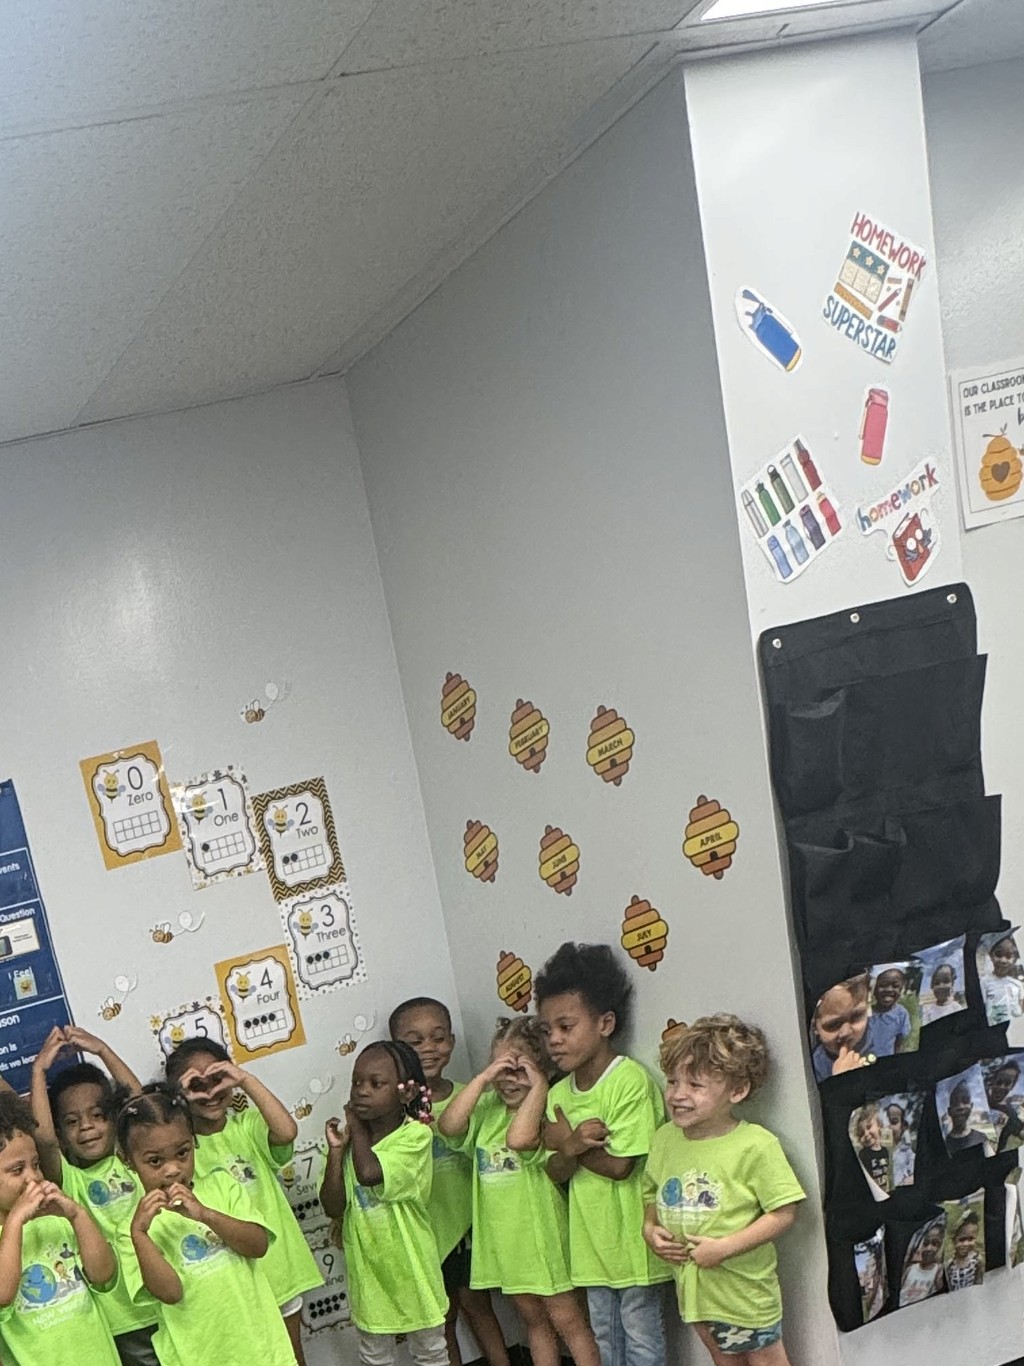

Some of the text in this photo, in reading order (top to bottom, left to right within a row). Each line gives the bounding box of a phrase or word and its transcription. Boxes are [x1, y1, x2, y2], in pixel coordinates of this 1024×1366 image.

[850, 211, 927, 281] HOMEWORK
[823, 295, 897, 359] SUPERSTAR
[963, 385, 978, 399] OUR
[989, 395, 1014, 411] PLACE
[857, 463, 939, 532] homework
[597, 737, 624, 758] MARCH
[127, 791, 154, 807] Zero
[217, 788, 227, 811] 1
[213, 812, 239, 827] One
[295, 802, 312, 826] 2
[295, 825, 319, 839] Two
[700, 832, 723, 849] APRIL
[320, 904, 334, 927] 3
[315, 927, 346, 943] Three
[260, 967, 273, 989] 4
[256, 991, 280, 1006] Four
[194, 1017, 208, 1039] 5
[9, 1059, 22, 1068] we
[301, 1156, 313, 1180] 7
[296, 1182, 318, 1197] Sev
[323, 1253, 334, 1275] 9
